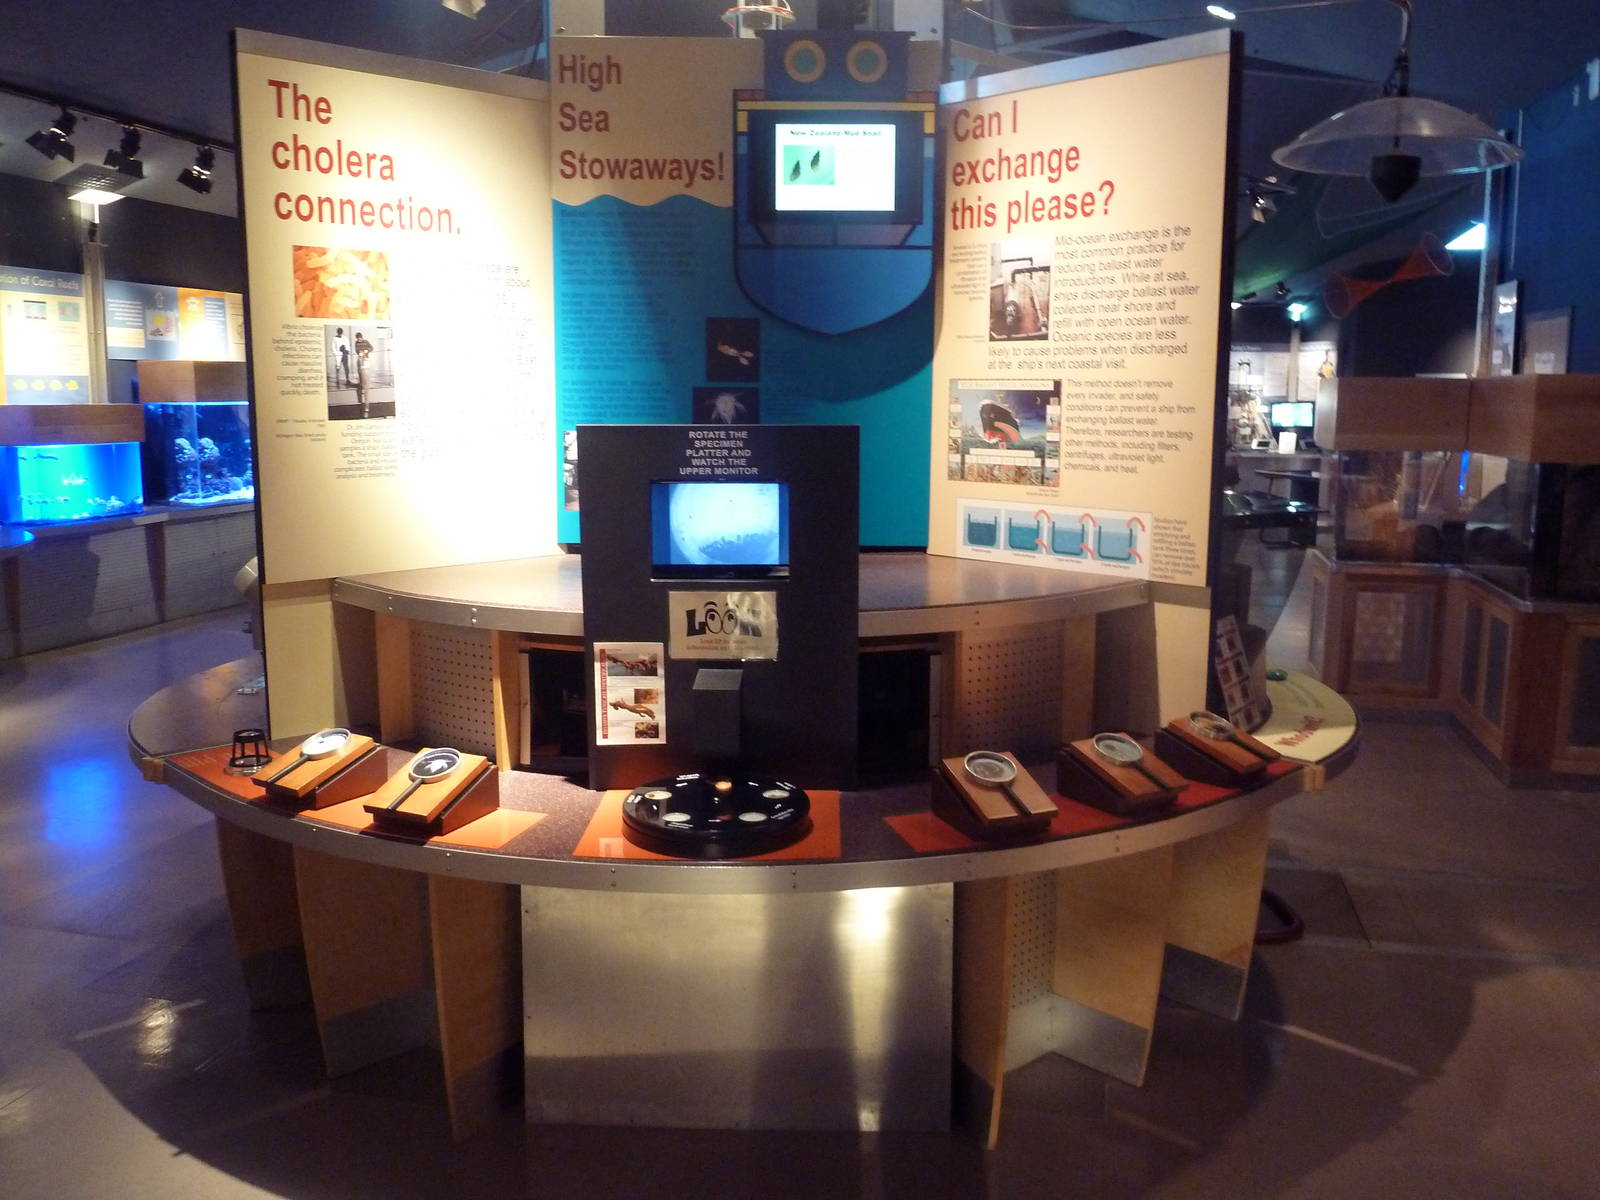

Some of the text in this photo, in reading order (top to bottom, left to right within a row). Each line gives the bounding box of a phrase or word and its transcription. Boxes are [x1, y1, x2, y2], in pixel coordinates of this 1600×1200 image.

[559, 54, 622, 92] High
[268, 79, 332, 125] The
[559, 102, 610, 132] Sea
[953, 100, 1018, 142] Can I
[271, 133, 394, 182] cholera
[559, 150, 725, 188] Stowaways!
[952, 144, 1080, 187] exchange
[273, 191, 461, 234] connection.
[951, 179, 1116, 234] this please?
[685, 448, 752, 457] PLATTER AND
[688, 430, 749, 439] ROTATE THE
[693, 439, 744, 448] SPECIMEN
[679, 466, 760, 475] UPPER MONITOR
[690, 458, 748, 467] WATCH THE
